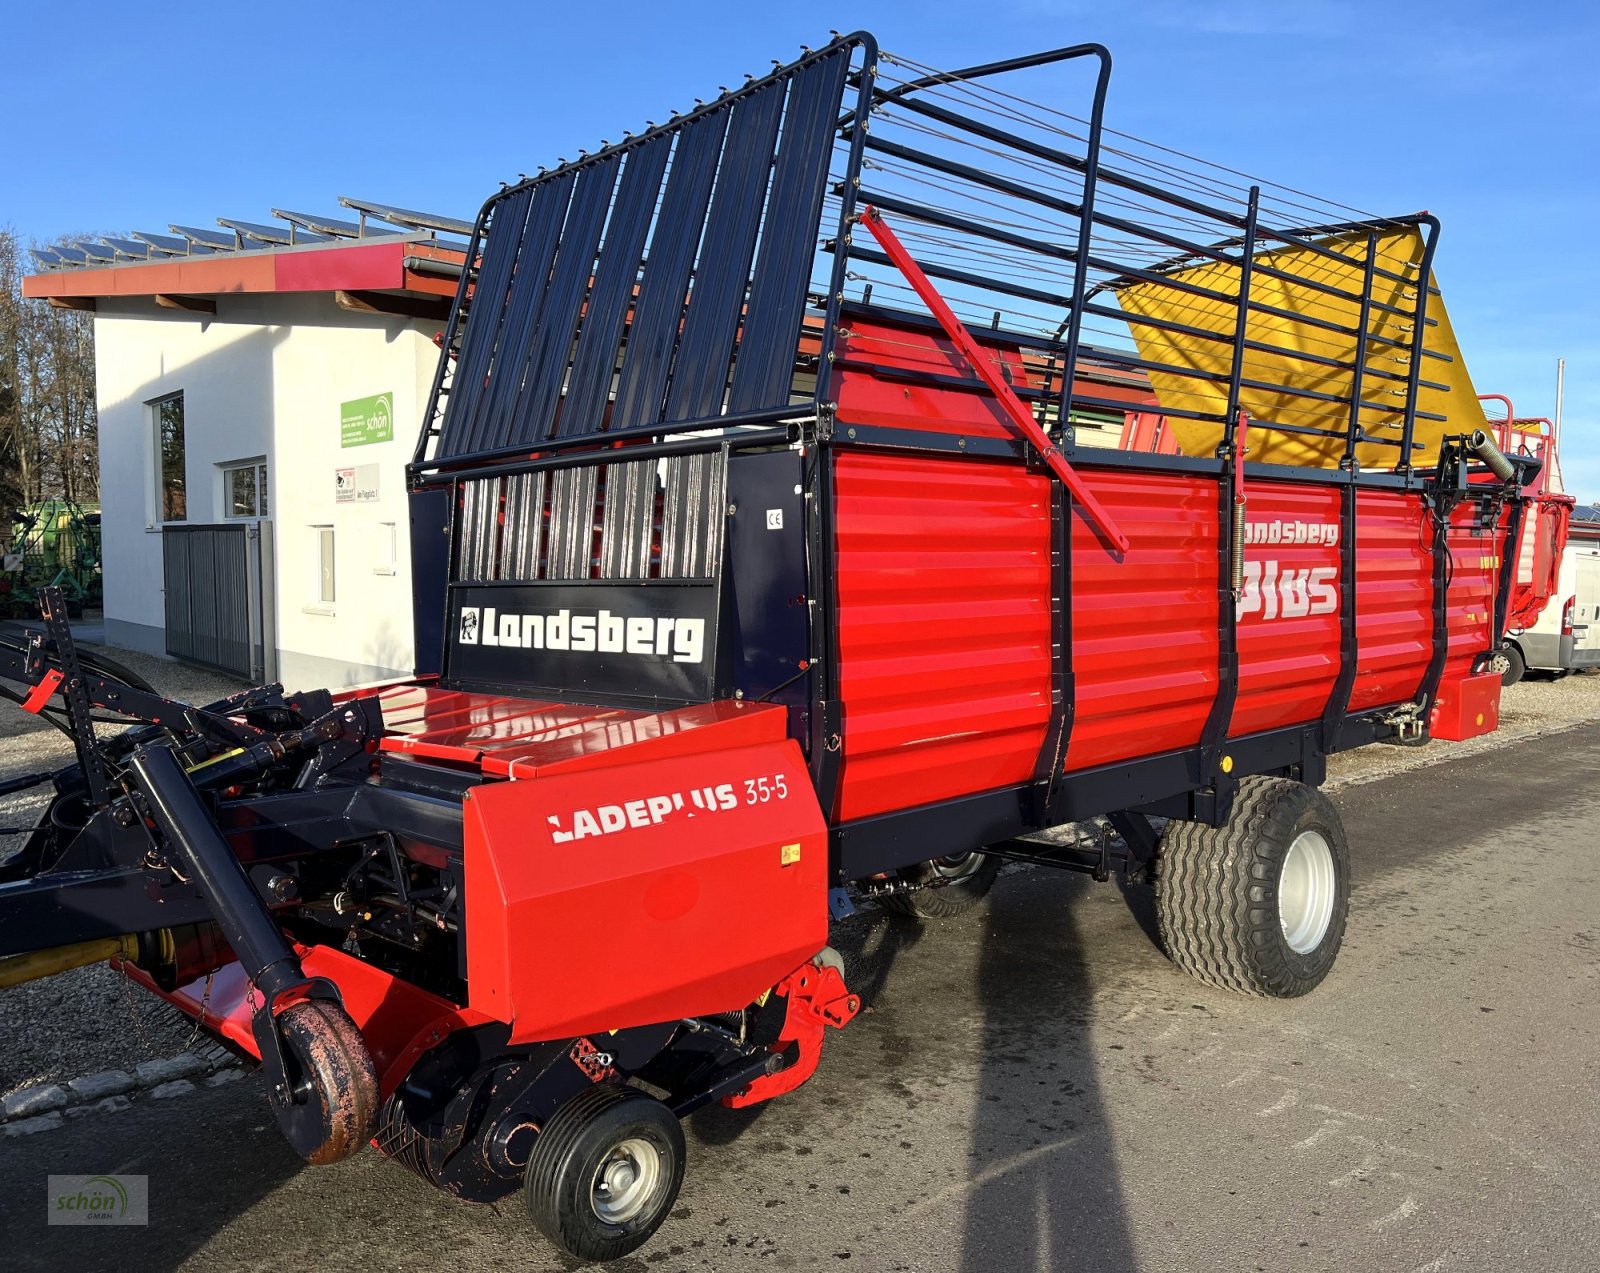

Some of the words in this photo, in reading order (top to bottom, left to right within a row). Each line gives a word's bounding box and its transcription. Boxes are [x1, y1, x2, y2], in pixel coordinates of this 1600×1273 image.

[366, 412, 387, 431] schön
[769, 513, 781, 526] CE
[1244, 520, 1338, 547] andsberg
[482, 607, 706, 663] Landsberg
[744, 774, 788, 805] 35-5
